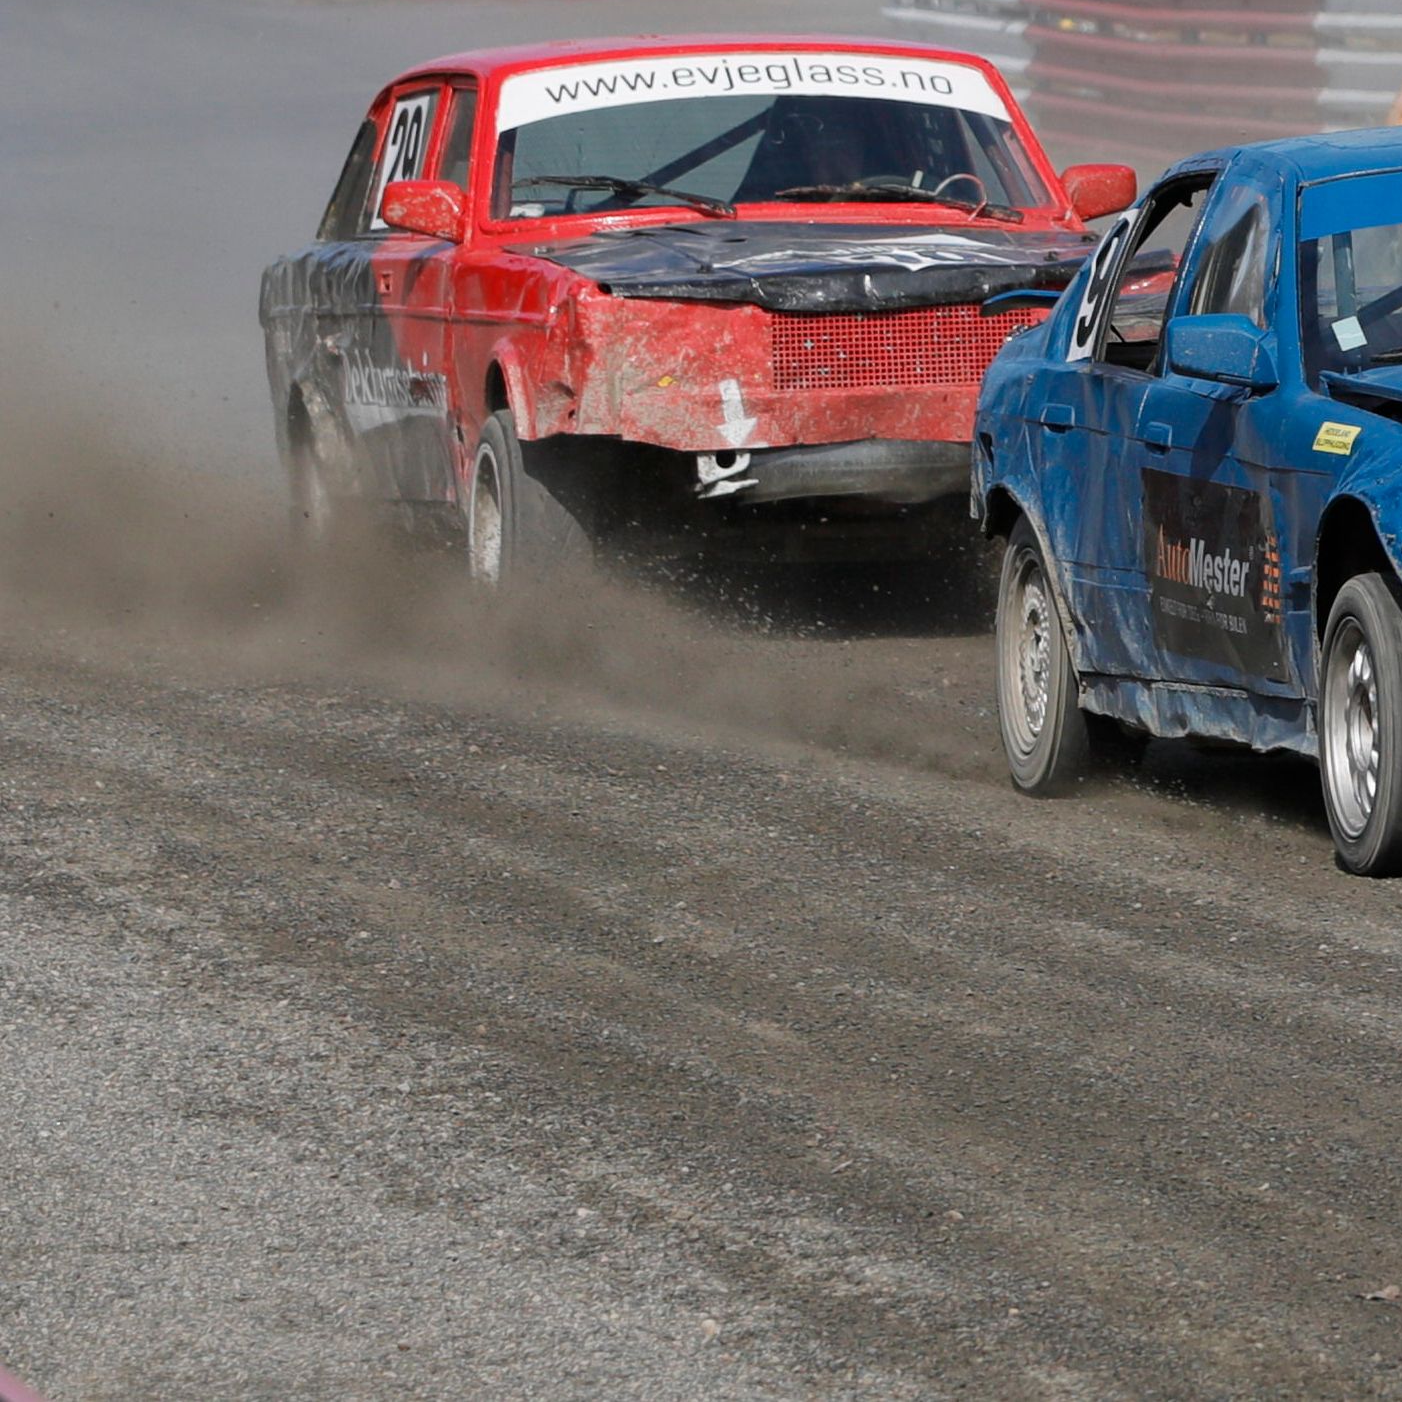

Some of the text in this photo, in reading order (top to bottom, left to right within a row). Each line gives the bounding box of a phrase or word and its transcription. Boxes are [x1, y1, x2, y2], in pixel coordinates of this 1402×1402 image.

[544, 57, 954, 104] www.evjeglass.no
[1076, 217, 1130, 348] 9
[1157, 523, 1250, 598] AutoMester
